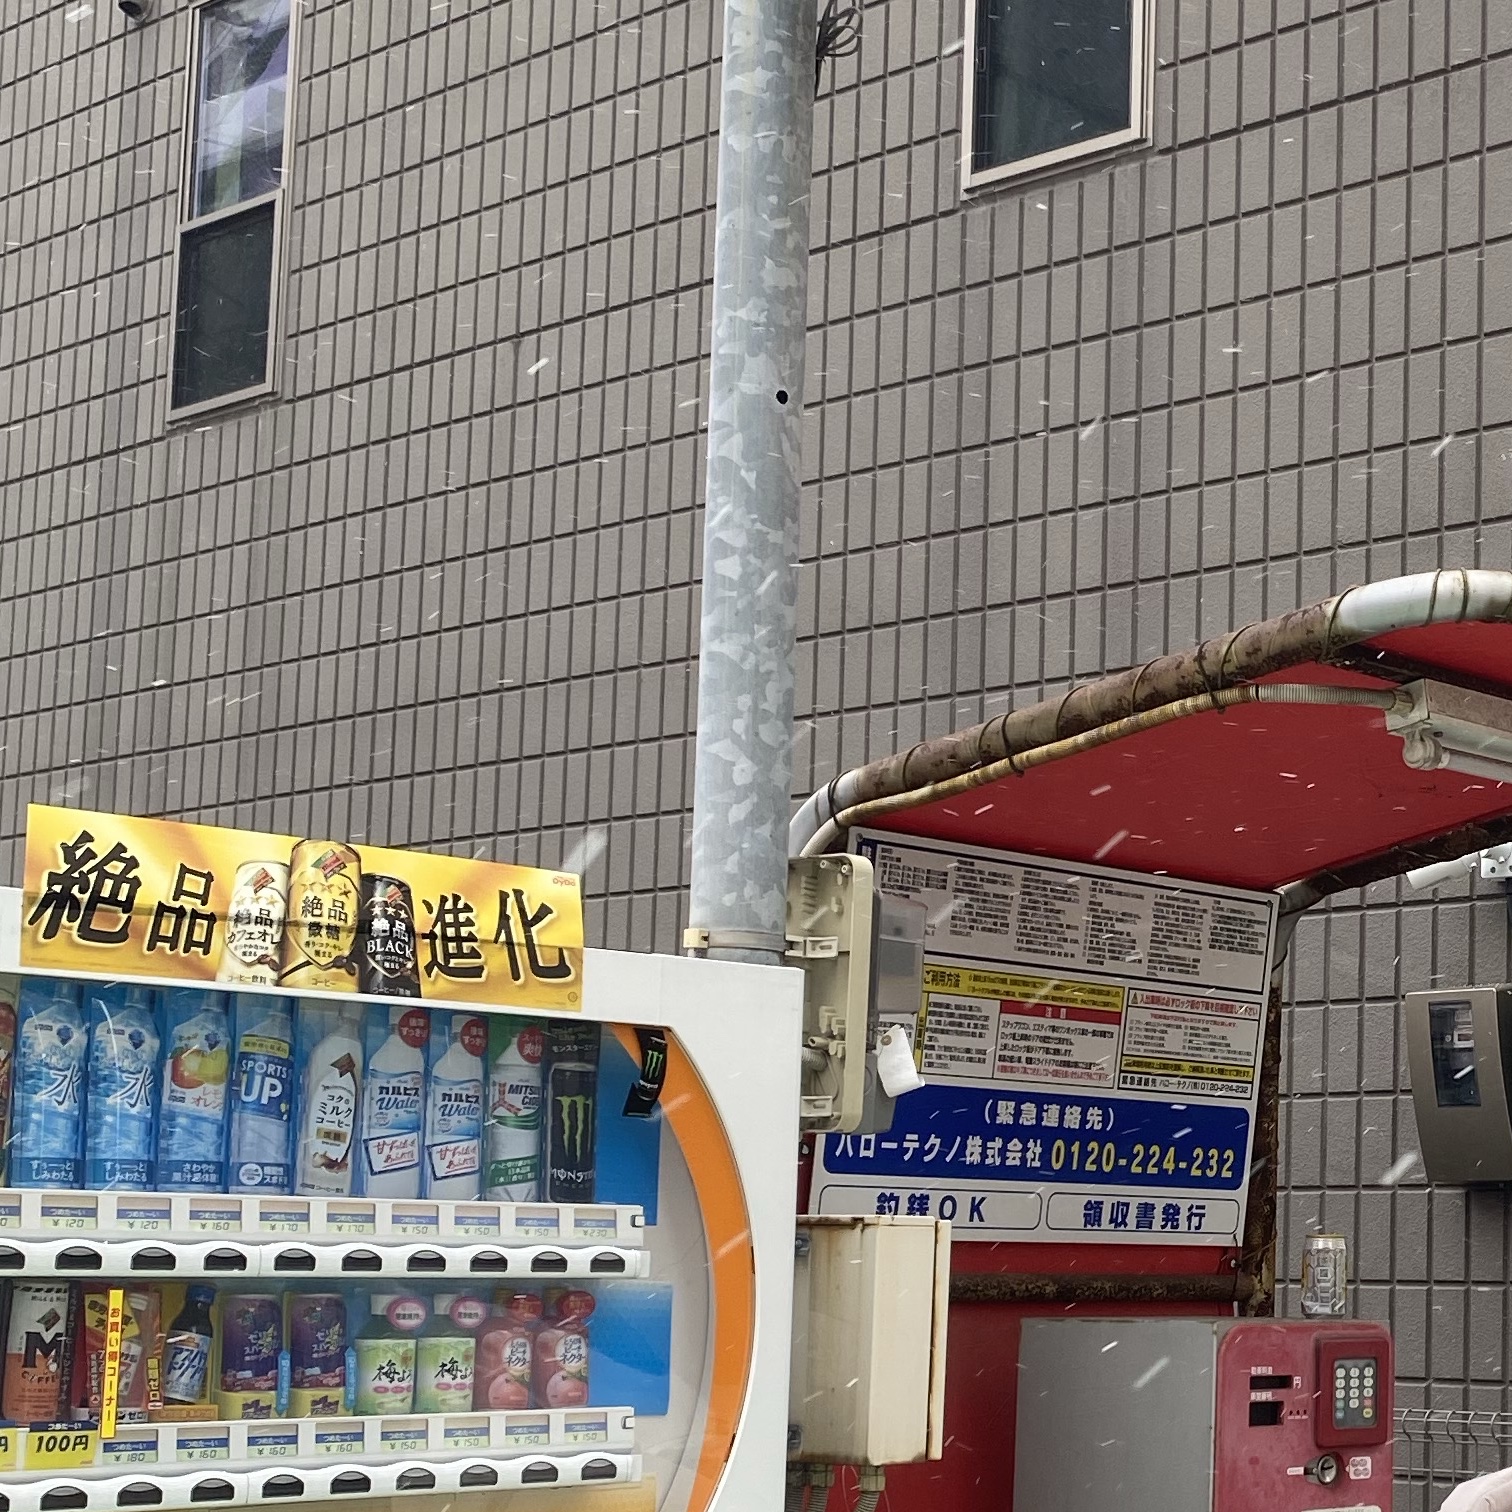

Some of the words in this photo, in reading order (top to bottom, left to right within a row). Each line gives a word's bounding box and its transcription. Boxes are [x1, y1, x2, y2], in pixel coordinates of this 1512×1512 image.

[27, 829, 217, 955] 絶品
[421, 888, 572, 982] 進化
[300, 894, 349, 924] 絶品
[370, 917, 410, 942] 絶品
[366, 939, 414, 959] BLACK
[37, 1063, 82, 1107] 水
[241, 1059, 288, 1079] SPORTS
[107, 1066, 154, 1109] 水
[239, 1072, 283, 1106] UP
[984, 1099, 1116, 1131] (緊急連絡先)
[834, 1132, 1042, 1169] ハローテクノ株式会社
[1050, 1138, 1236, 1179] 0120-224-232
[1083, 1199, 1207, 1232] 領収書発行
[36, 1434, 89, 1453] 100円
